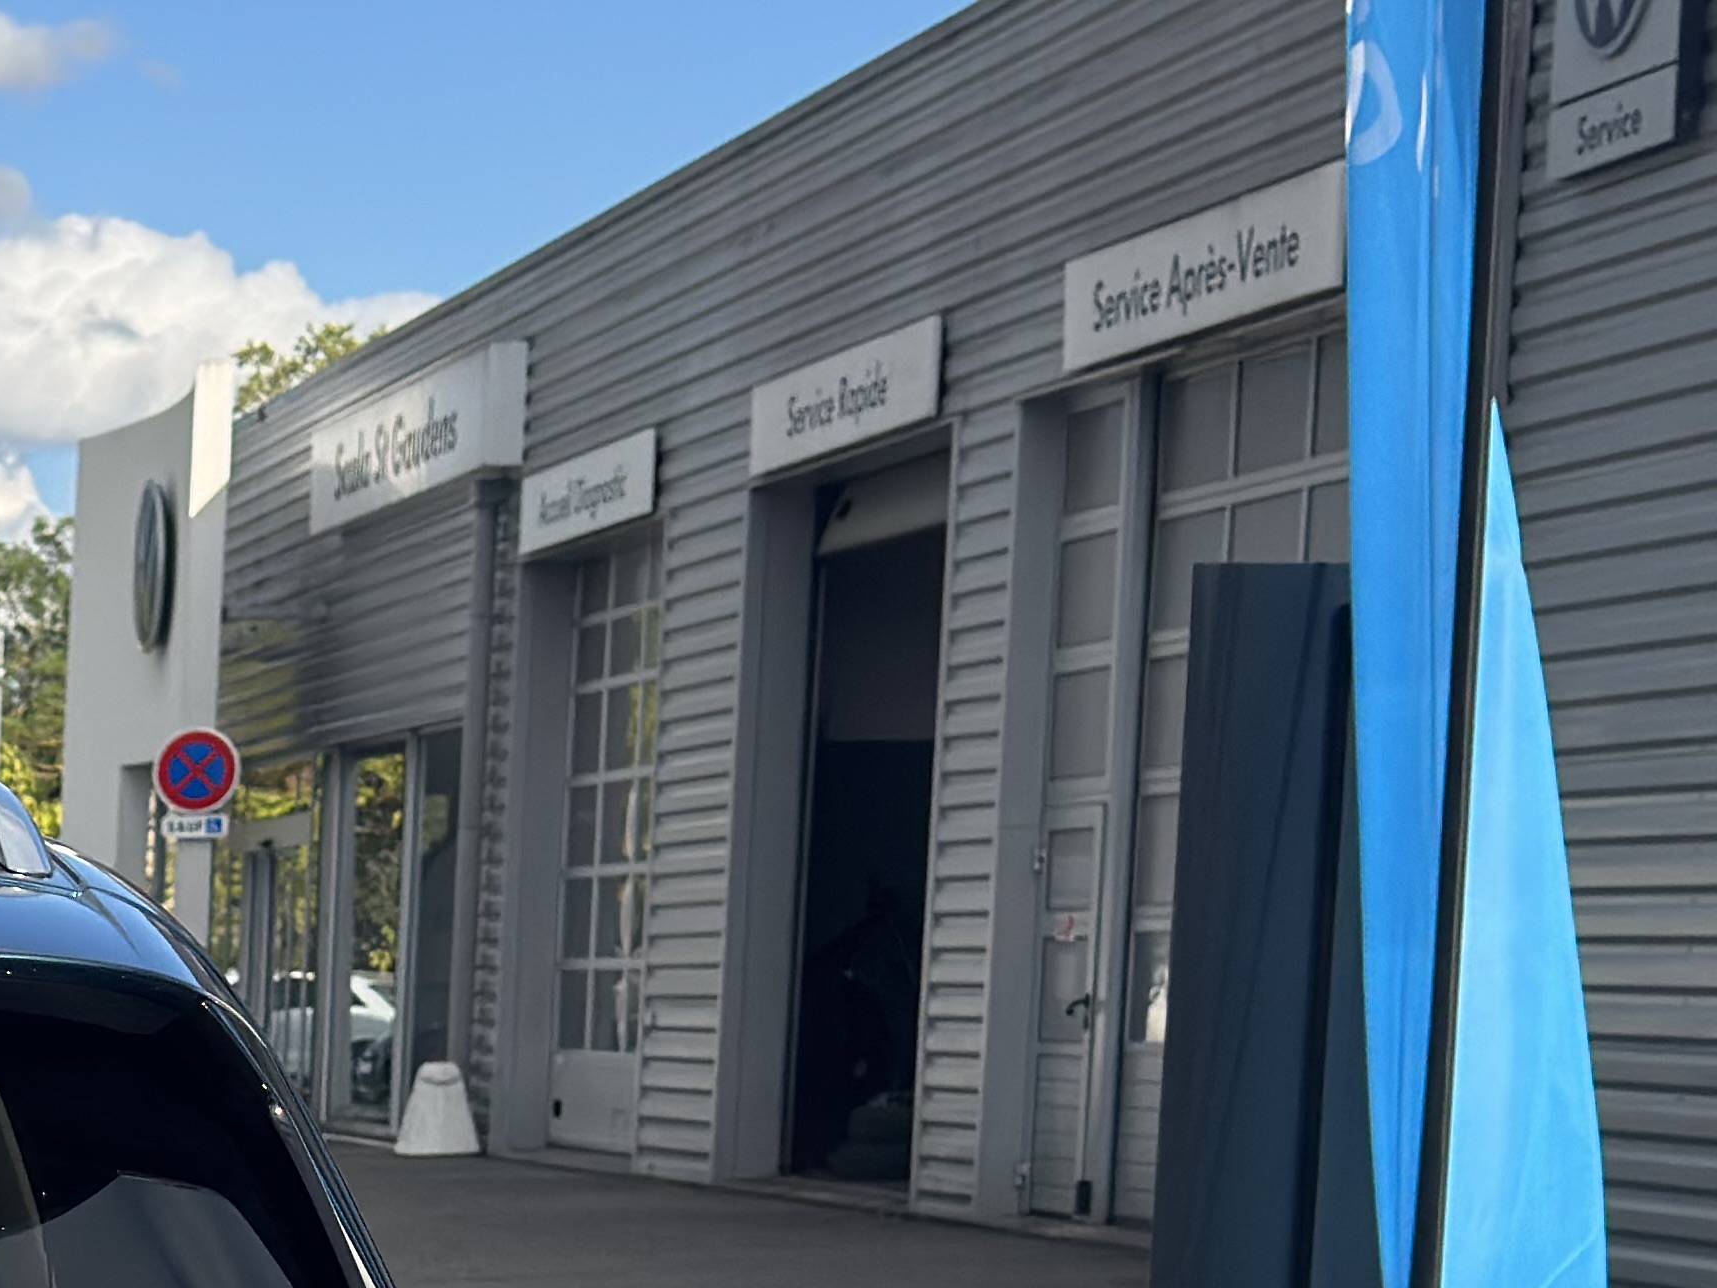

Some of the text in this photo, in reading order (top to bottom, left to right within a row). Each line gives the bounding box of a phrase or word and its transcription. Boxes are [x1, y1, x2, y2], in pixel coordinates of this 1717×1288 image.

[1577, 102, 1642, 156] Service
[1094, 223, 1300, 333] Service Après-Vente
[787, 361, 887, 438] Service Rapide
